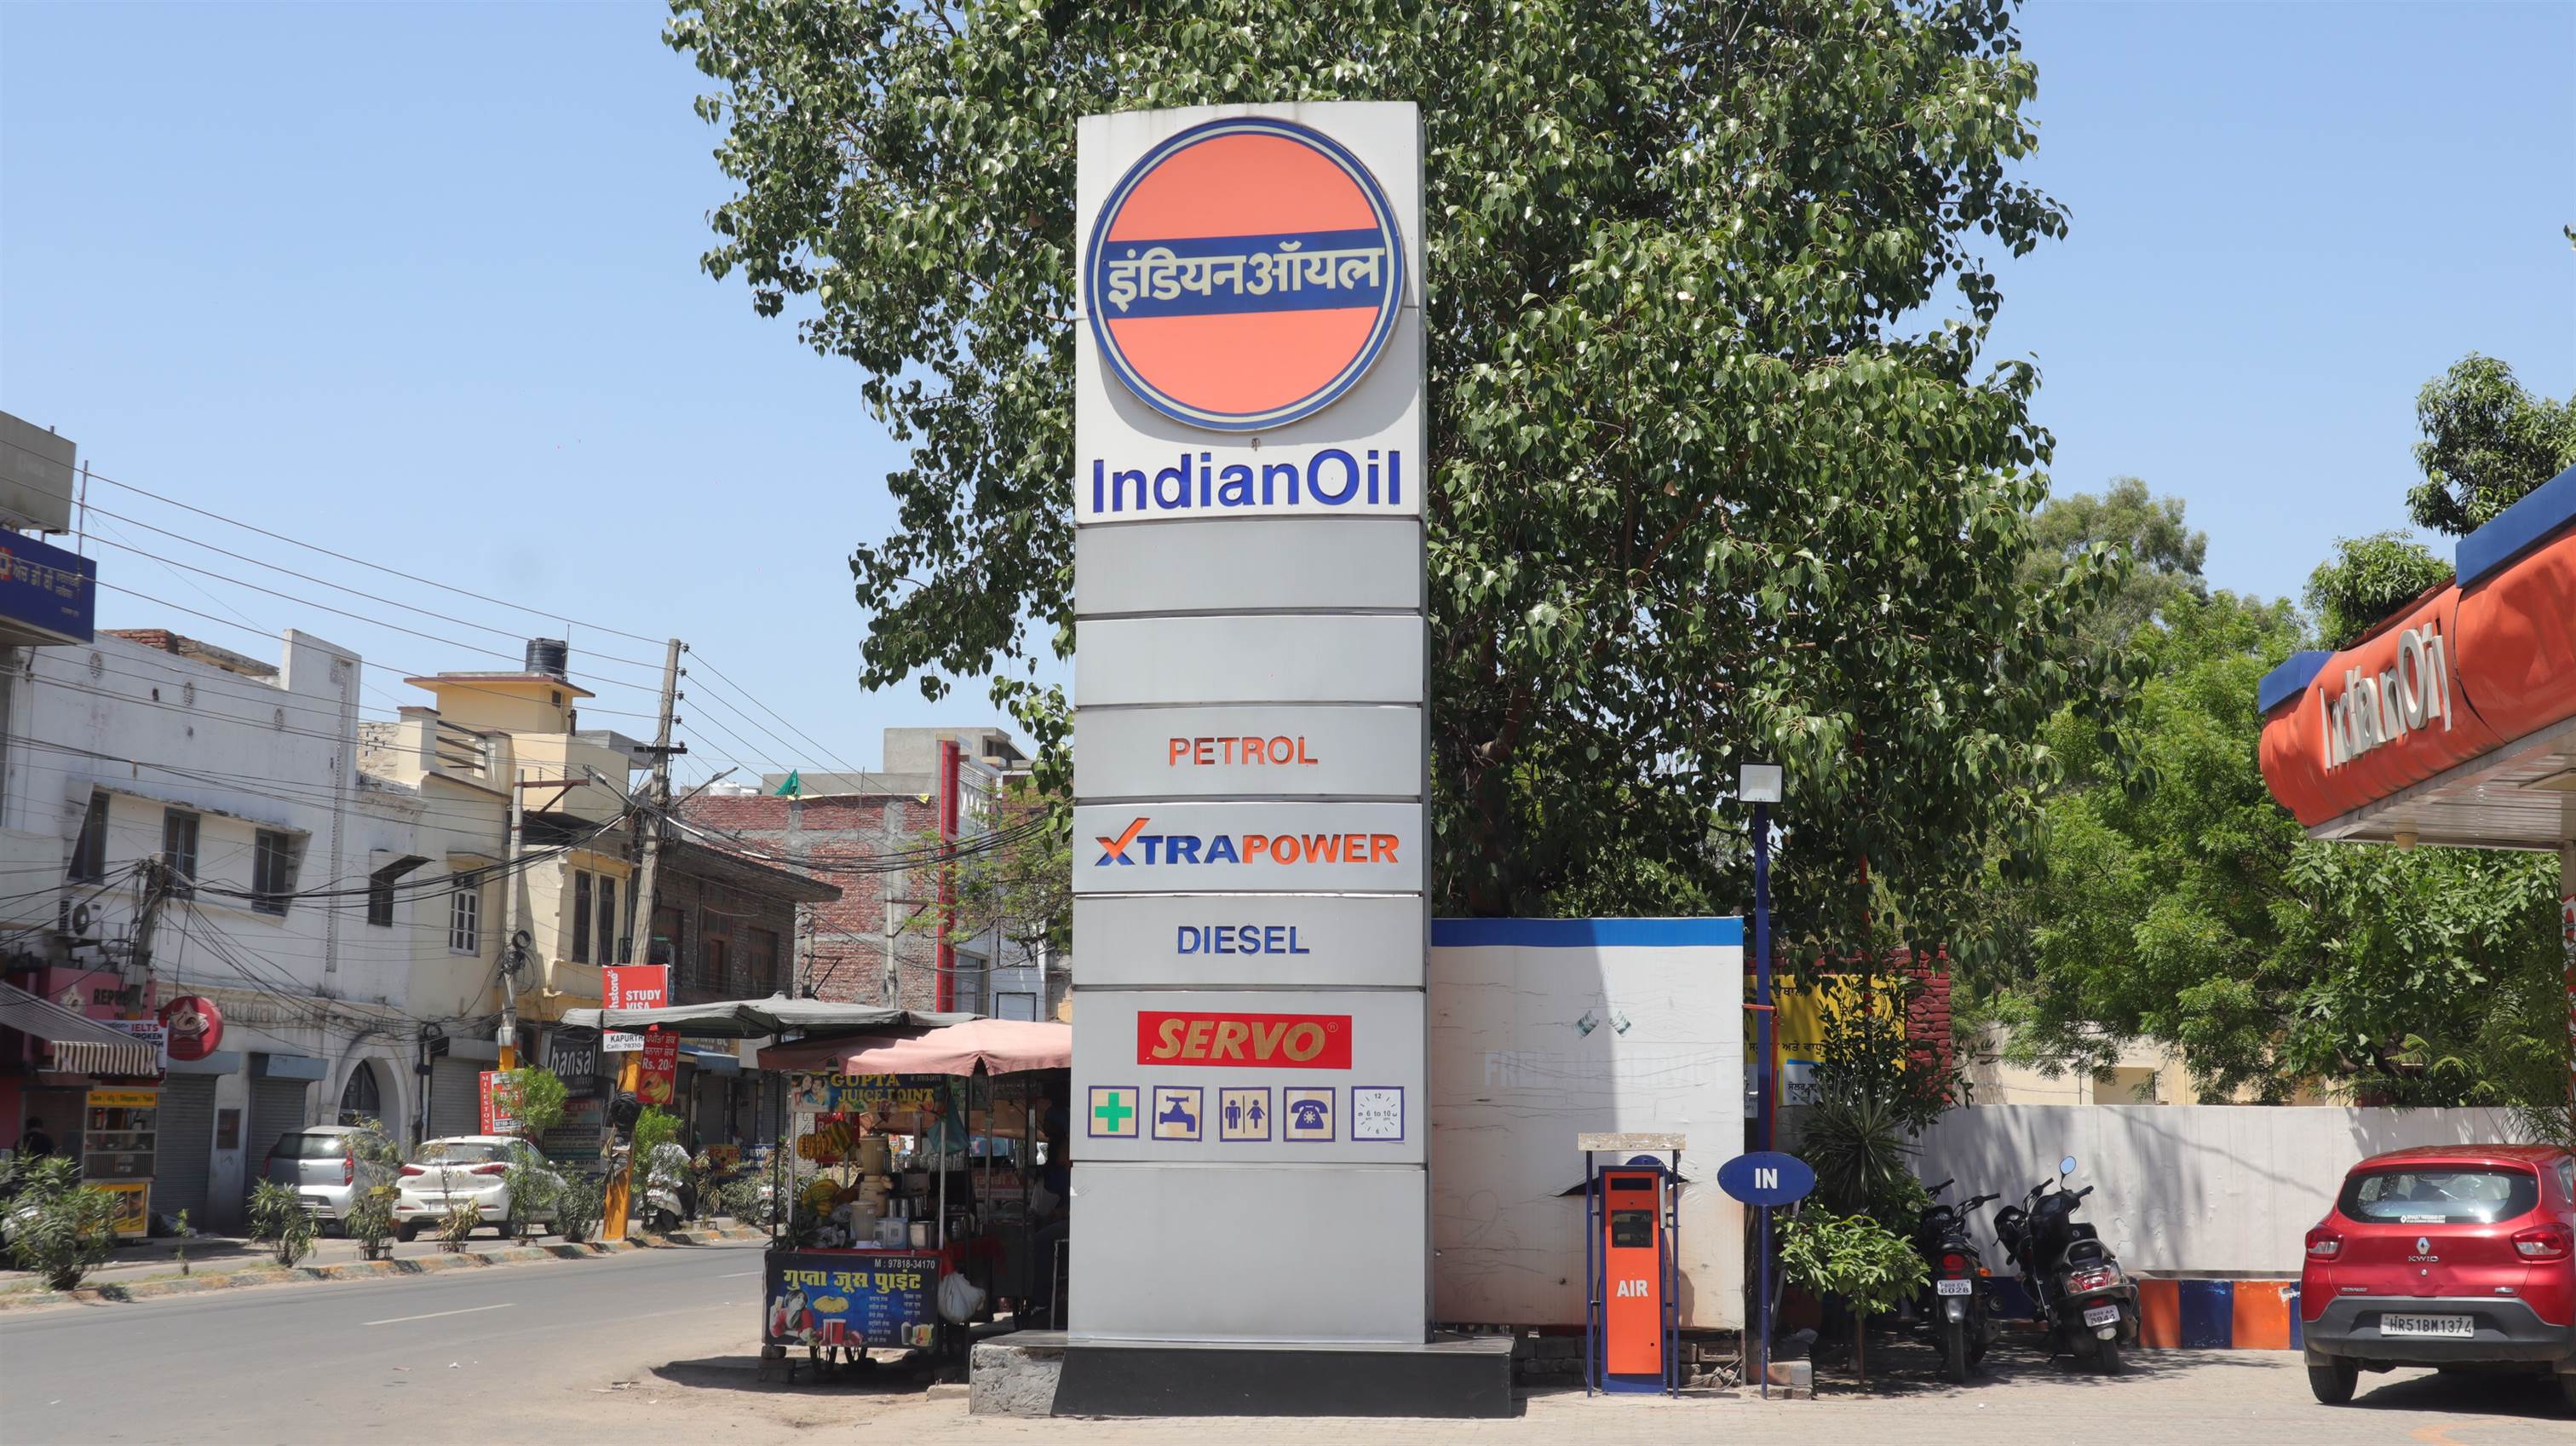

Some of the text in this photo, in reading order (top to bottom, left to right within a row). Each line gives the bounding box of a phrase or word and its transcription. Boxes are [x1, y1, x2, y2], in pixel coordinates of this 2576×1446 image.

[1107, 241, 1385, 313] इंडियनऑयल
[1092, 448, 1401, 514] IndianOil
[2318, 622, 2452, 770] IndianOil
[1169, 735, 1319, 766] PETROL
[1095, 817, 1400, 867] XTRAPOWER
[1177, 925, 1310, 955] DIESEL
[608, 973, 619, 1009] hstone
[626, 989, 661, 1001] STUDY
[611, 1034, 643, 1043] KAPURTH
[1152, 1018, 1325, 1062] SERVO
[550, 1044, 596, 1077] bansal
[642, 1057, 655, 1070] Rs.
[831, 1074, 900, 1087] GUPTA
[838, 1088, 883, 1103] JUICE
[1755, 1168, 1778, 1190] IN
[888, 1259, 935, 1270] 97818-34170
[1616, 1279, 1648, 1297] AIR
[2389, 1317, 2472, 1334] HR51BM1374
